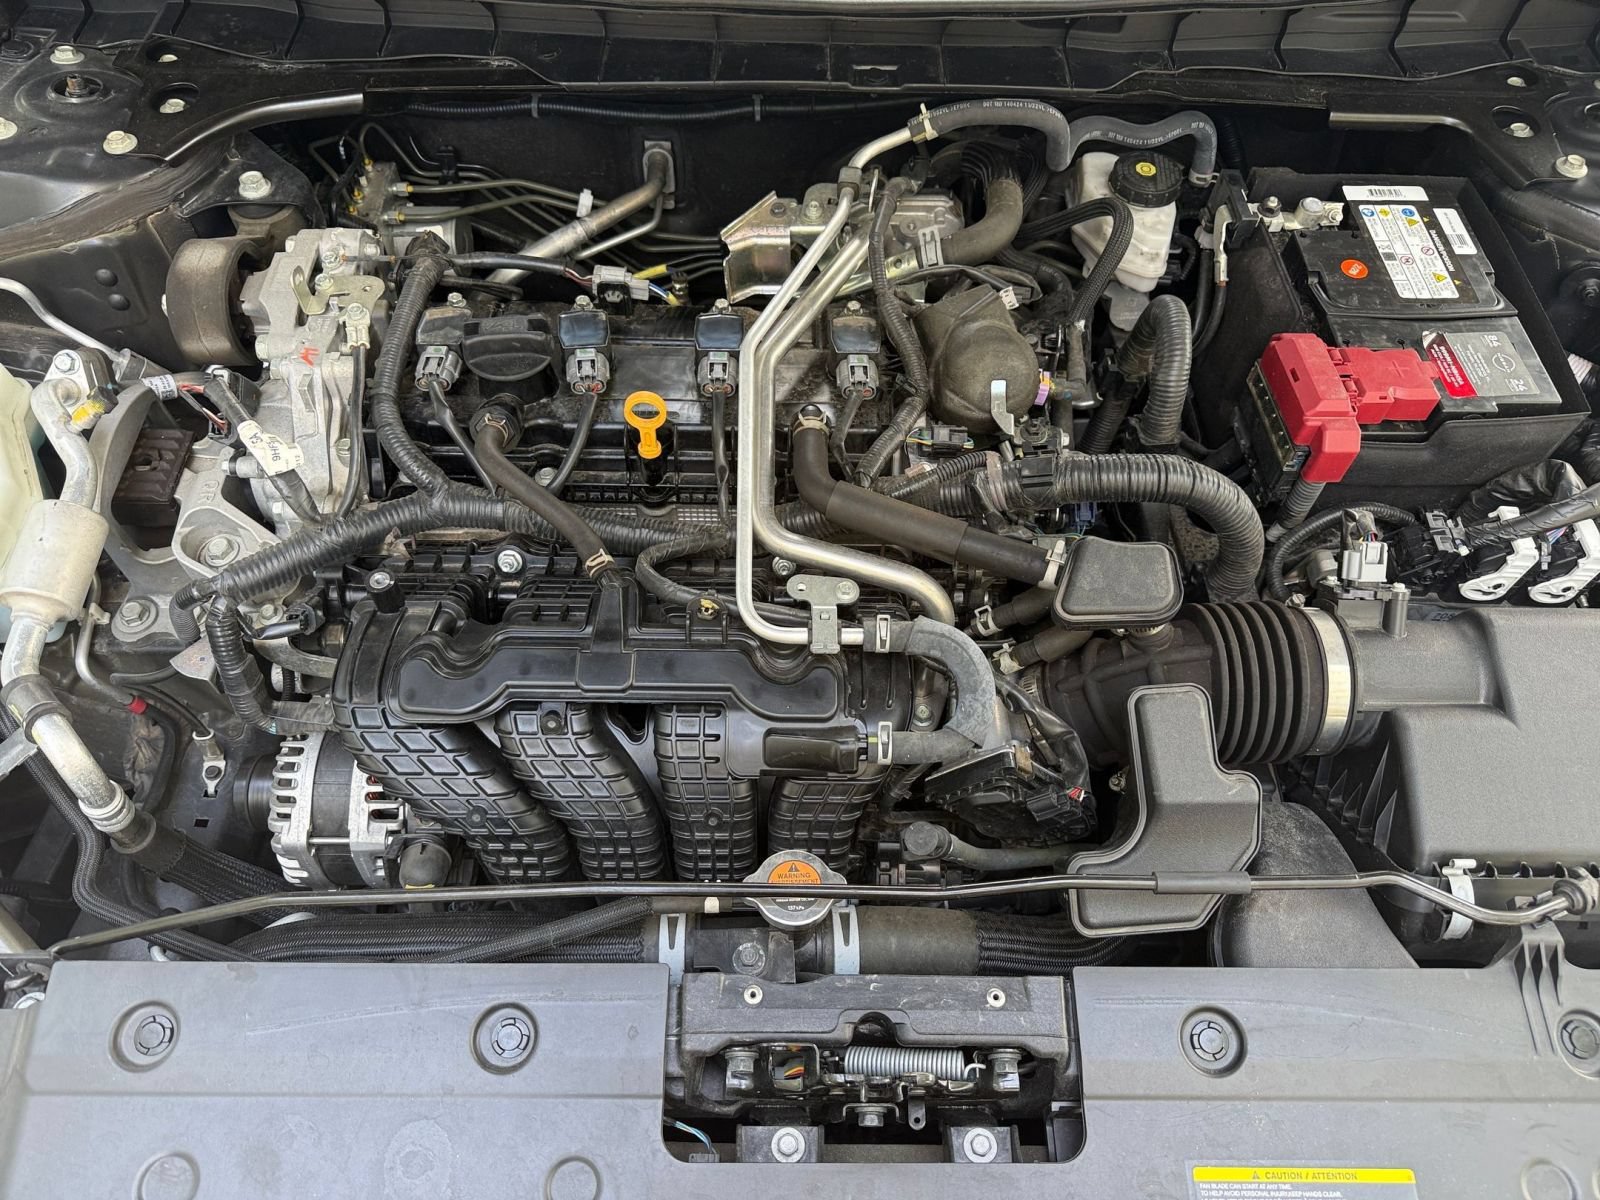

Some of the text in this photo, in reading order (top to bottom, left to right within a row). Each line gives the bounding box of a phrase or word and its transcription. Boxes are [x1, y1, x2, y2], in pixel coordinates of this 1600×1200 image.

[1487, 334, 1501, 348] 84
[1497, 352, 1511, 373] NISSAN
[1265, 1171, 1303, 1180] CAUTION
[1312, 1172, 1358, 1180] ATTENTION
